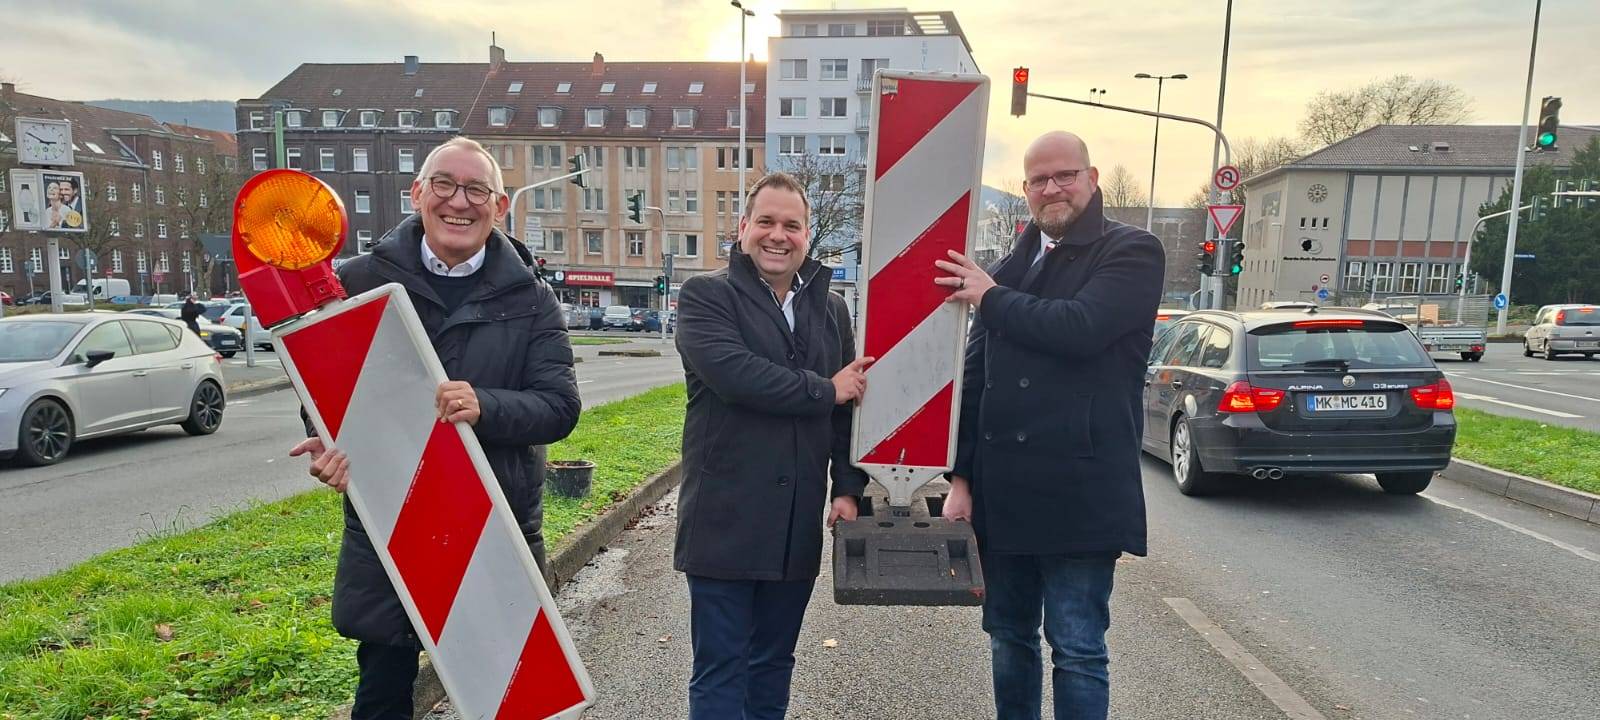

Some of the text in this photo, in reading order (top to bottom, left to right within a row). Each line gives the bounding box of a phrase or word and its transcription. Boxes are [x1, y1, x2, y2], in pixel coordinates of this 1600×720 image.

[568, 274, 611, 282] SPIELHALLE
[1315, 395, 1384, 408] MK MC 416
